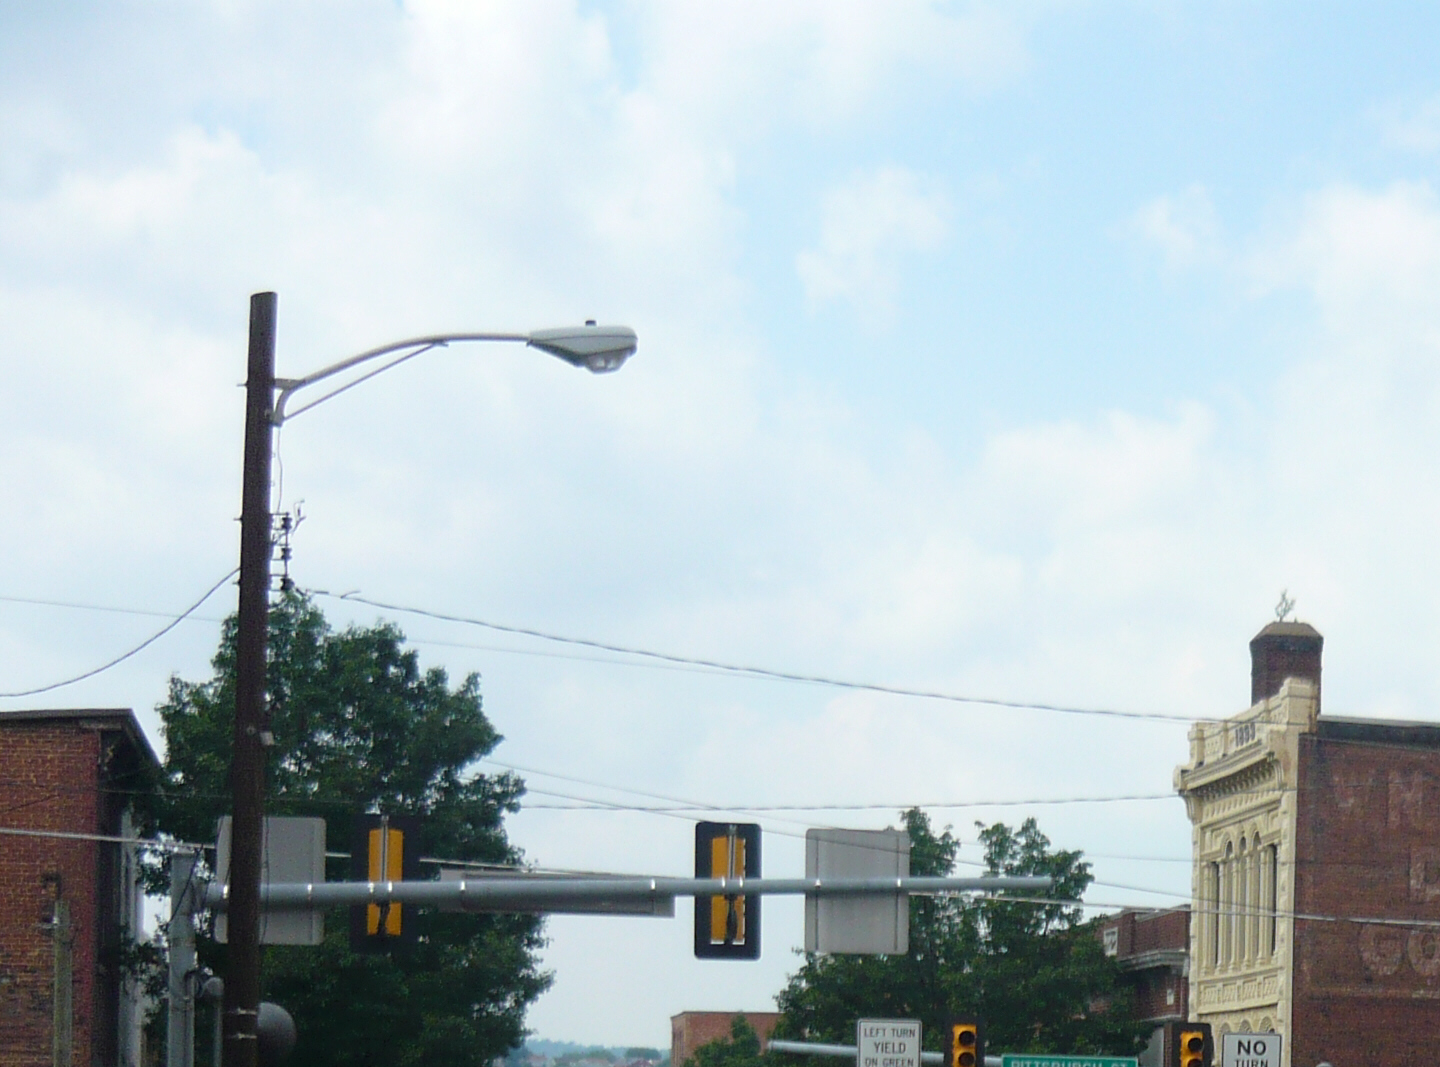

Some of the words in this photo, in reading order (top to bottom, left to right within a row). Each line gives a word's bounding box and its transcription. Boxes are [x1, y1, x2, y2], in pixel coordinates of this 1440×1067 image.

[864, 1028, 886, 1038] LEFT
[891, 1028, 916, 1038] TURN
[874, 1042, 906, 1054] YIELD
[1237, 1040, 1267, 1056] NO
[865, 1057, 878, 1067] ON
[882, 1057, 914, 1067] GREEN
